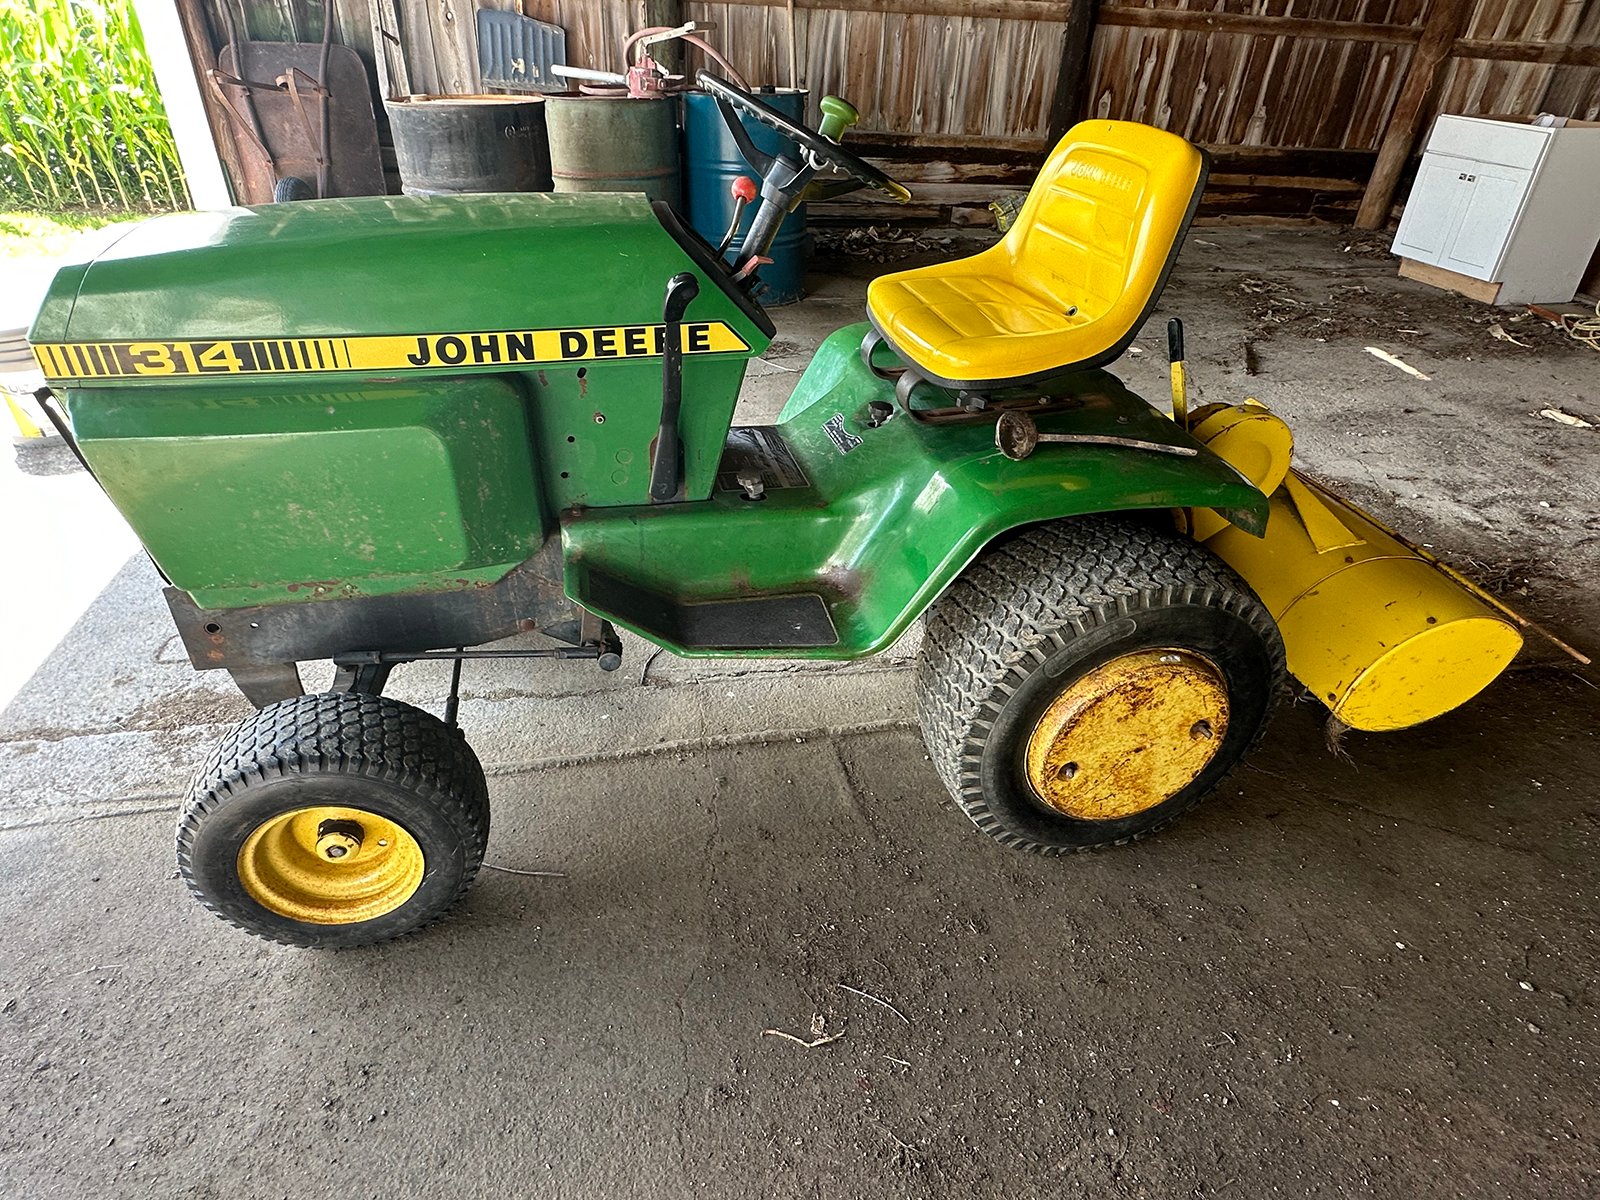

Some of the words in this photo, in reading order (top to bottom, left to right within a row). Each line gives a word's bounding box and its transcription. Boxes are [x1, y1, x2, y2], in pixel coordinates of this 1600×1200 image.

[128, 342, 244, 375] 314
[407, 333, 535, 366] JOHN
[560, 325, 711, 358] DEEE
